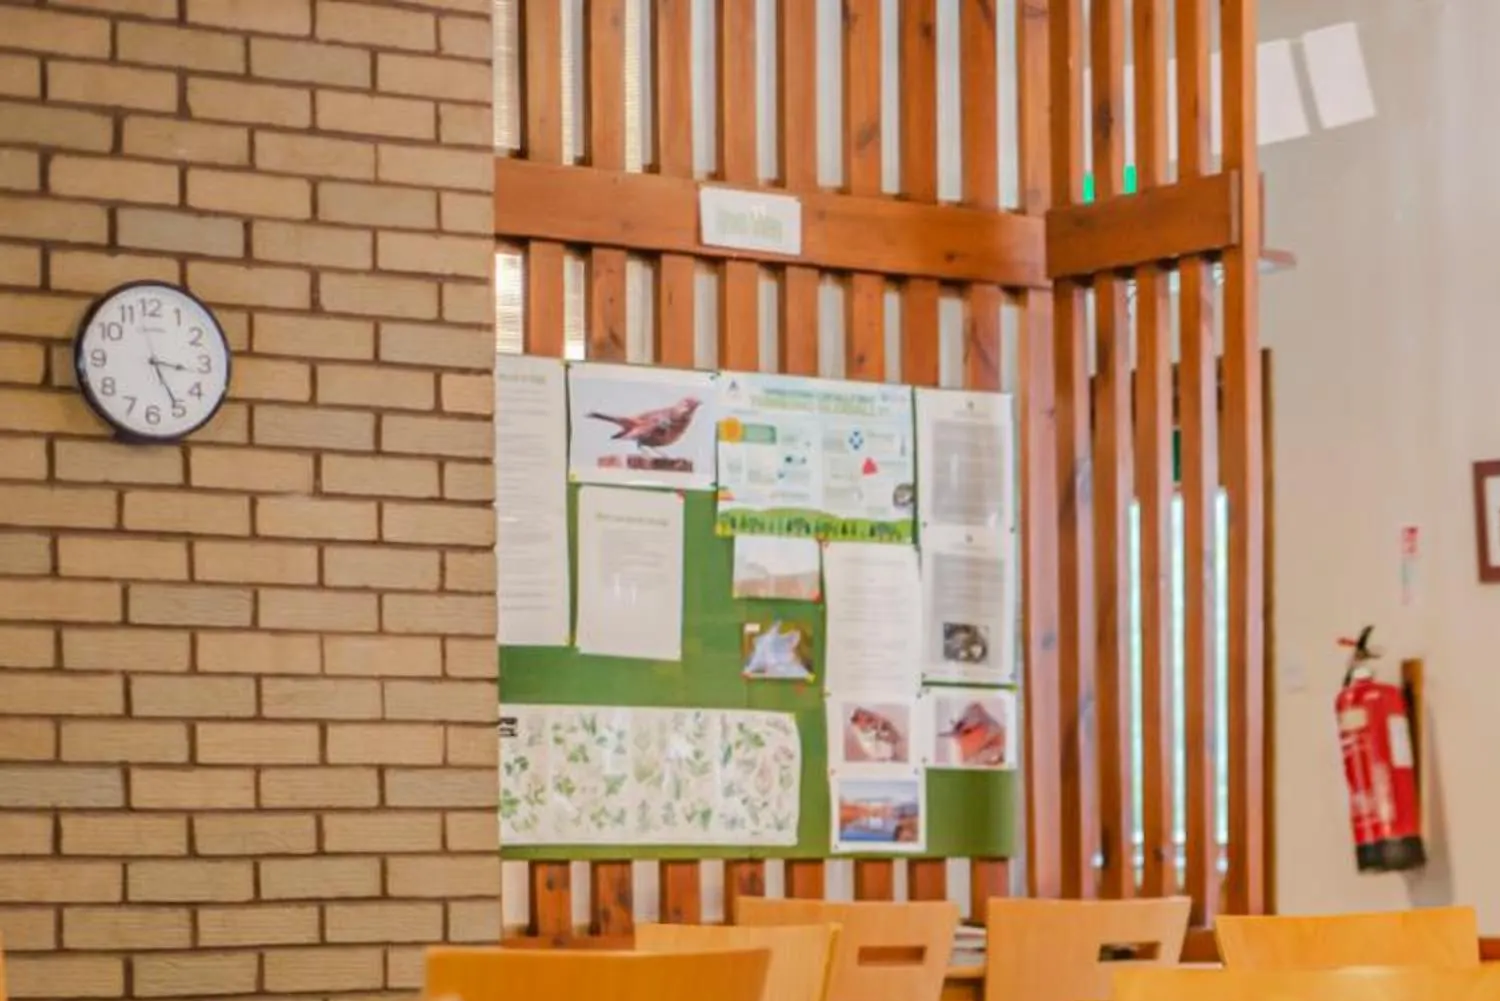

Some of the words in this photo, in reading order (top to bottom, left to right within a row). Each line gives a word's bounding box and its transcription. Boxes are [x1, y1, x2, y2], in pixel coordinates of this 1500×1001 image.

[121, 304, 135, 325] 11
[140, 298, 162, 317] 12
[174, 308, 182, 326] 1
[99, 321, 123, 342] 10
[189, 327, 204, 347] 2
[91, 348, 107, 368] 9
[197, 354, 212, 374] 3
[101, 376, 116, 397] 8
[188, 382, 203, 400] 4
[122, 395, 138, 416] 7
[145, 404, 161, 425] 6
[172, 399, 187, 418] 5
